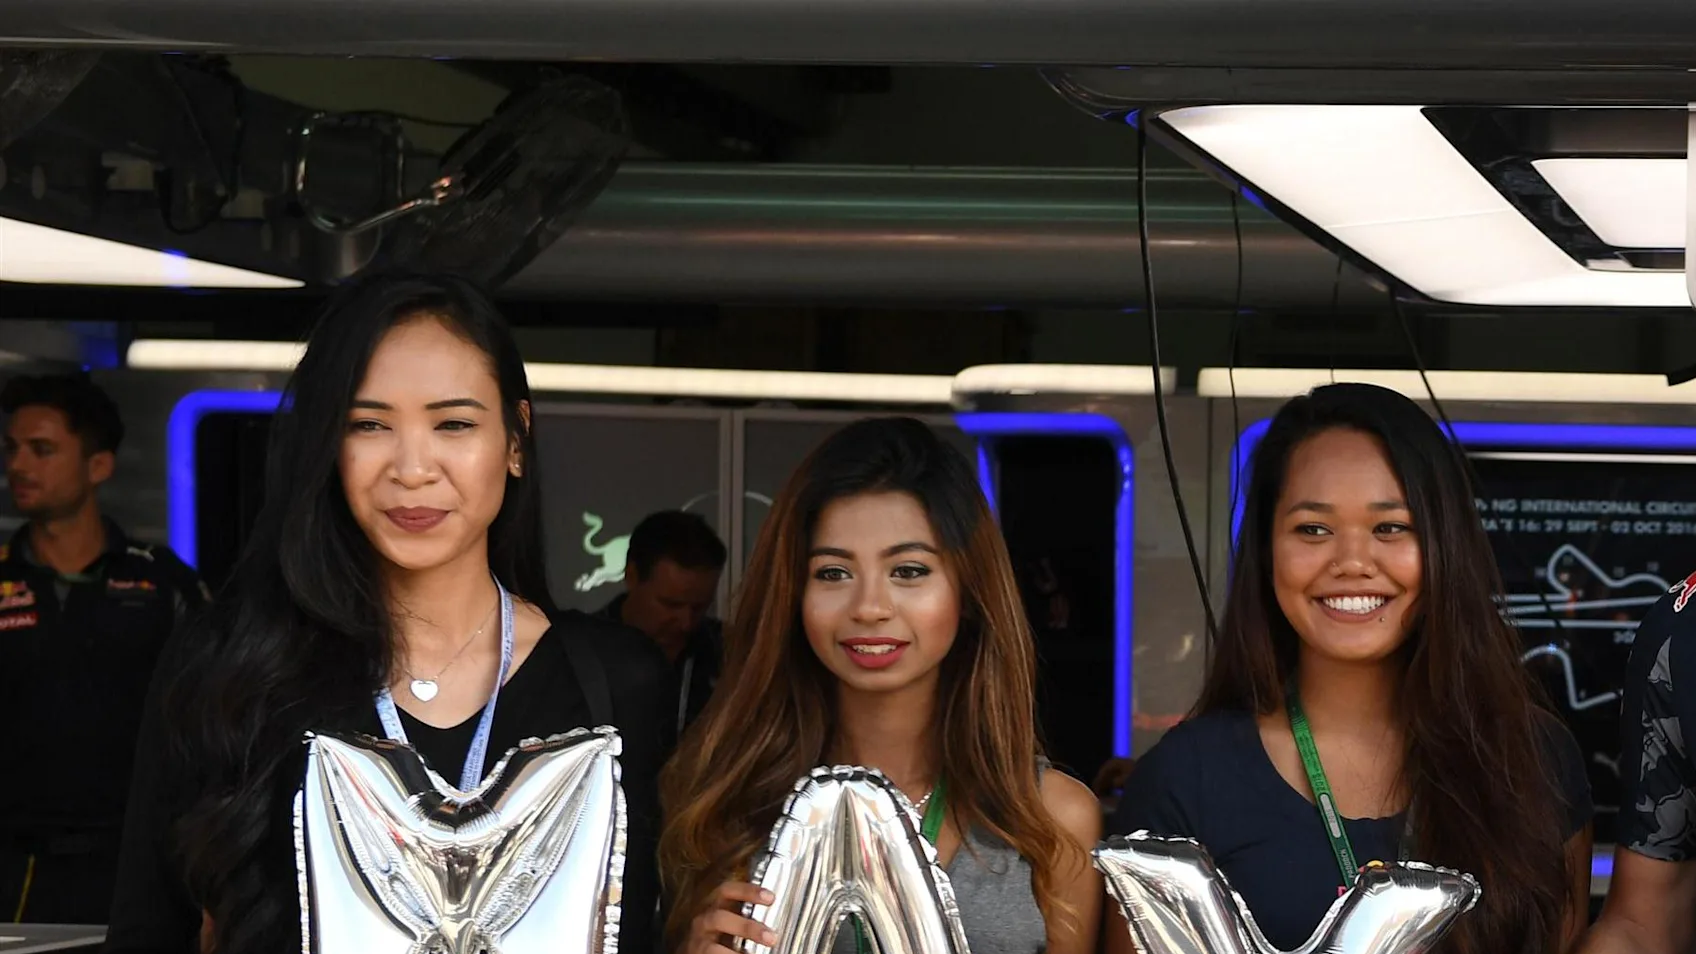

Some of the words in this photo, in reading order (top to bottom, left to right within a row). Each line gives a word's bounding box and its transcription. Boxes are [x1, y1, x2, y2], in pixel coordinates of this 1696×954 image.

[1520, 499, 1642, 514] INTERNATIONAL
[1566, 519, 1598, 533] SEPT
[1633, 520, 1661, 534] OCT
